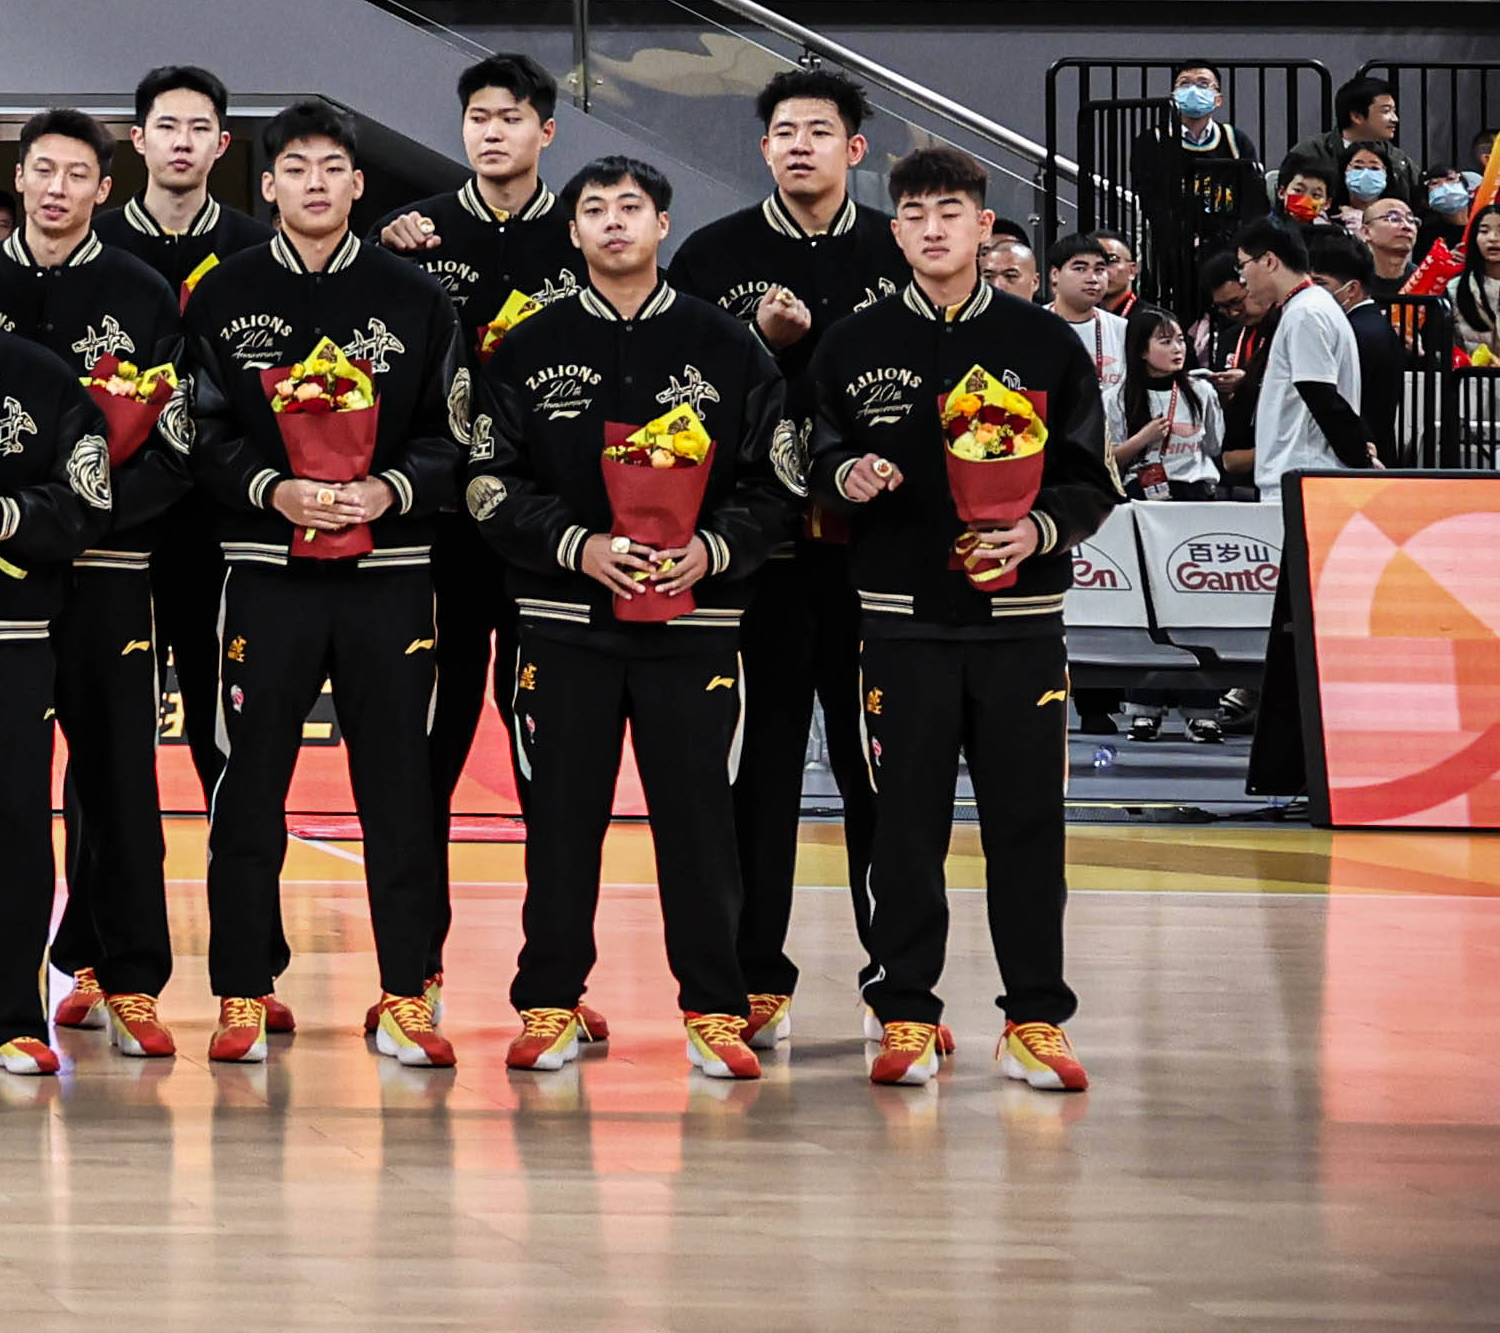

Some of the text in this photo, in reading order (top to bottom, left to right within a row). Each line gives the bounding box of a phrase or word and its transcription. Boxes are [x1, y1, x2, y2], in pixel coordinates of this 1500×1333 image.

[420, 260, 480, 283] LIONS
[220, 314, 293, 341] ZJLIONS
[525, 364, 602, 390] ZJLIONS
[847, 367, 923, 397] ZJLIONS
[1187, 543, 1270, 564] 百岁山
[1176, 562, 1281, 591] Gante
